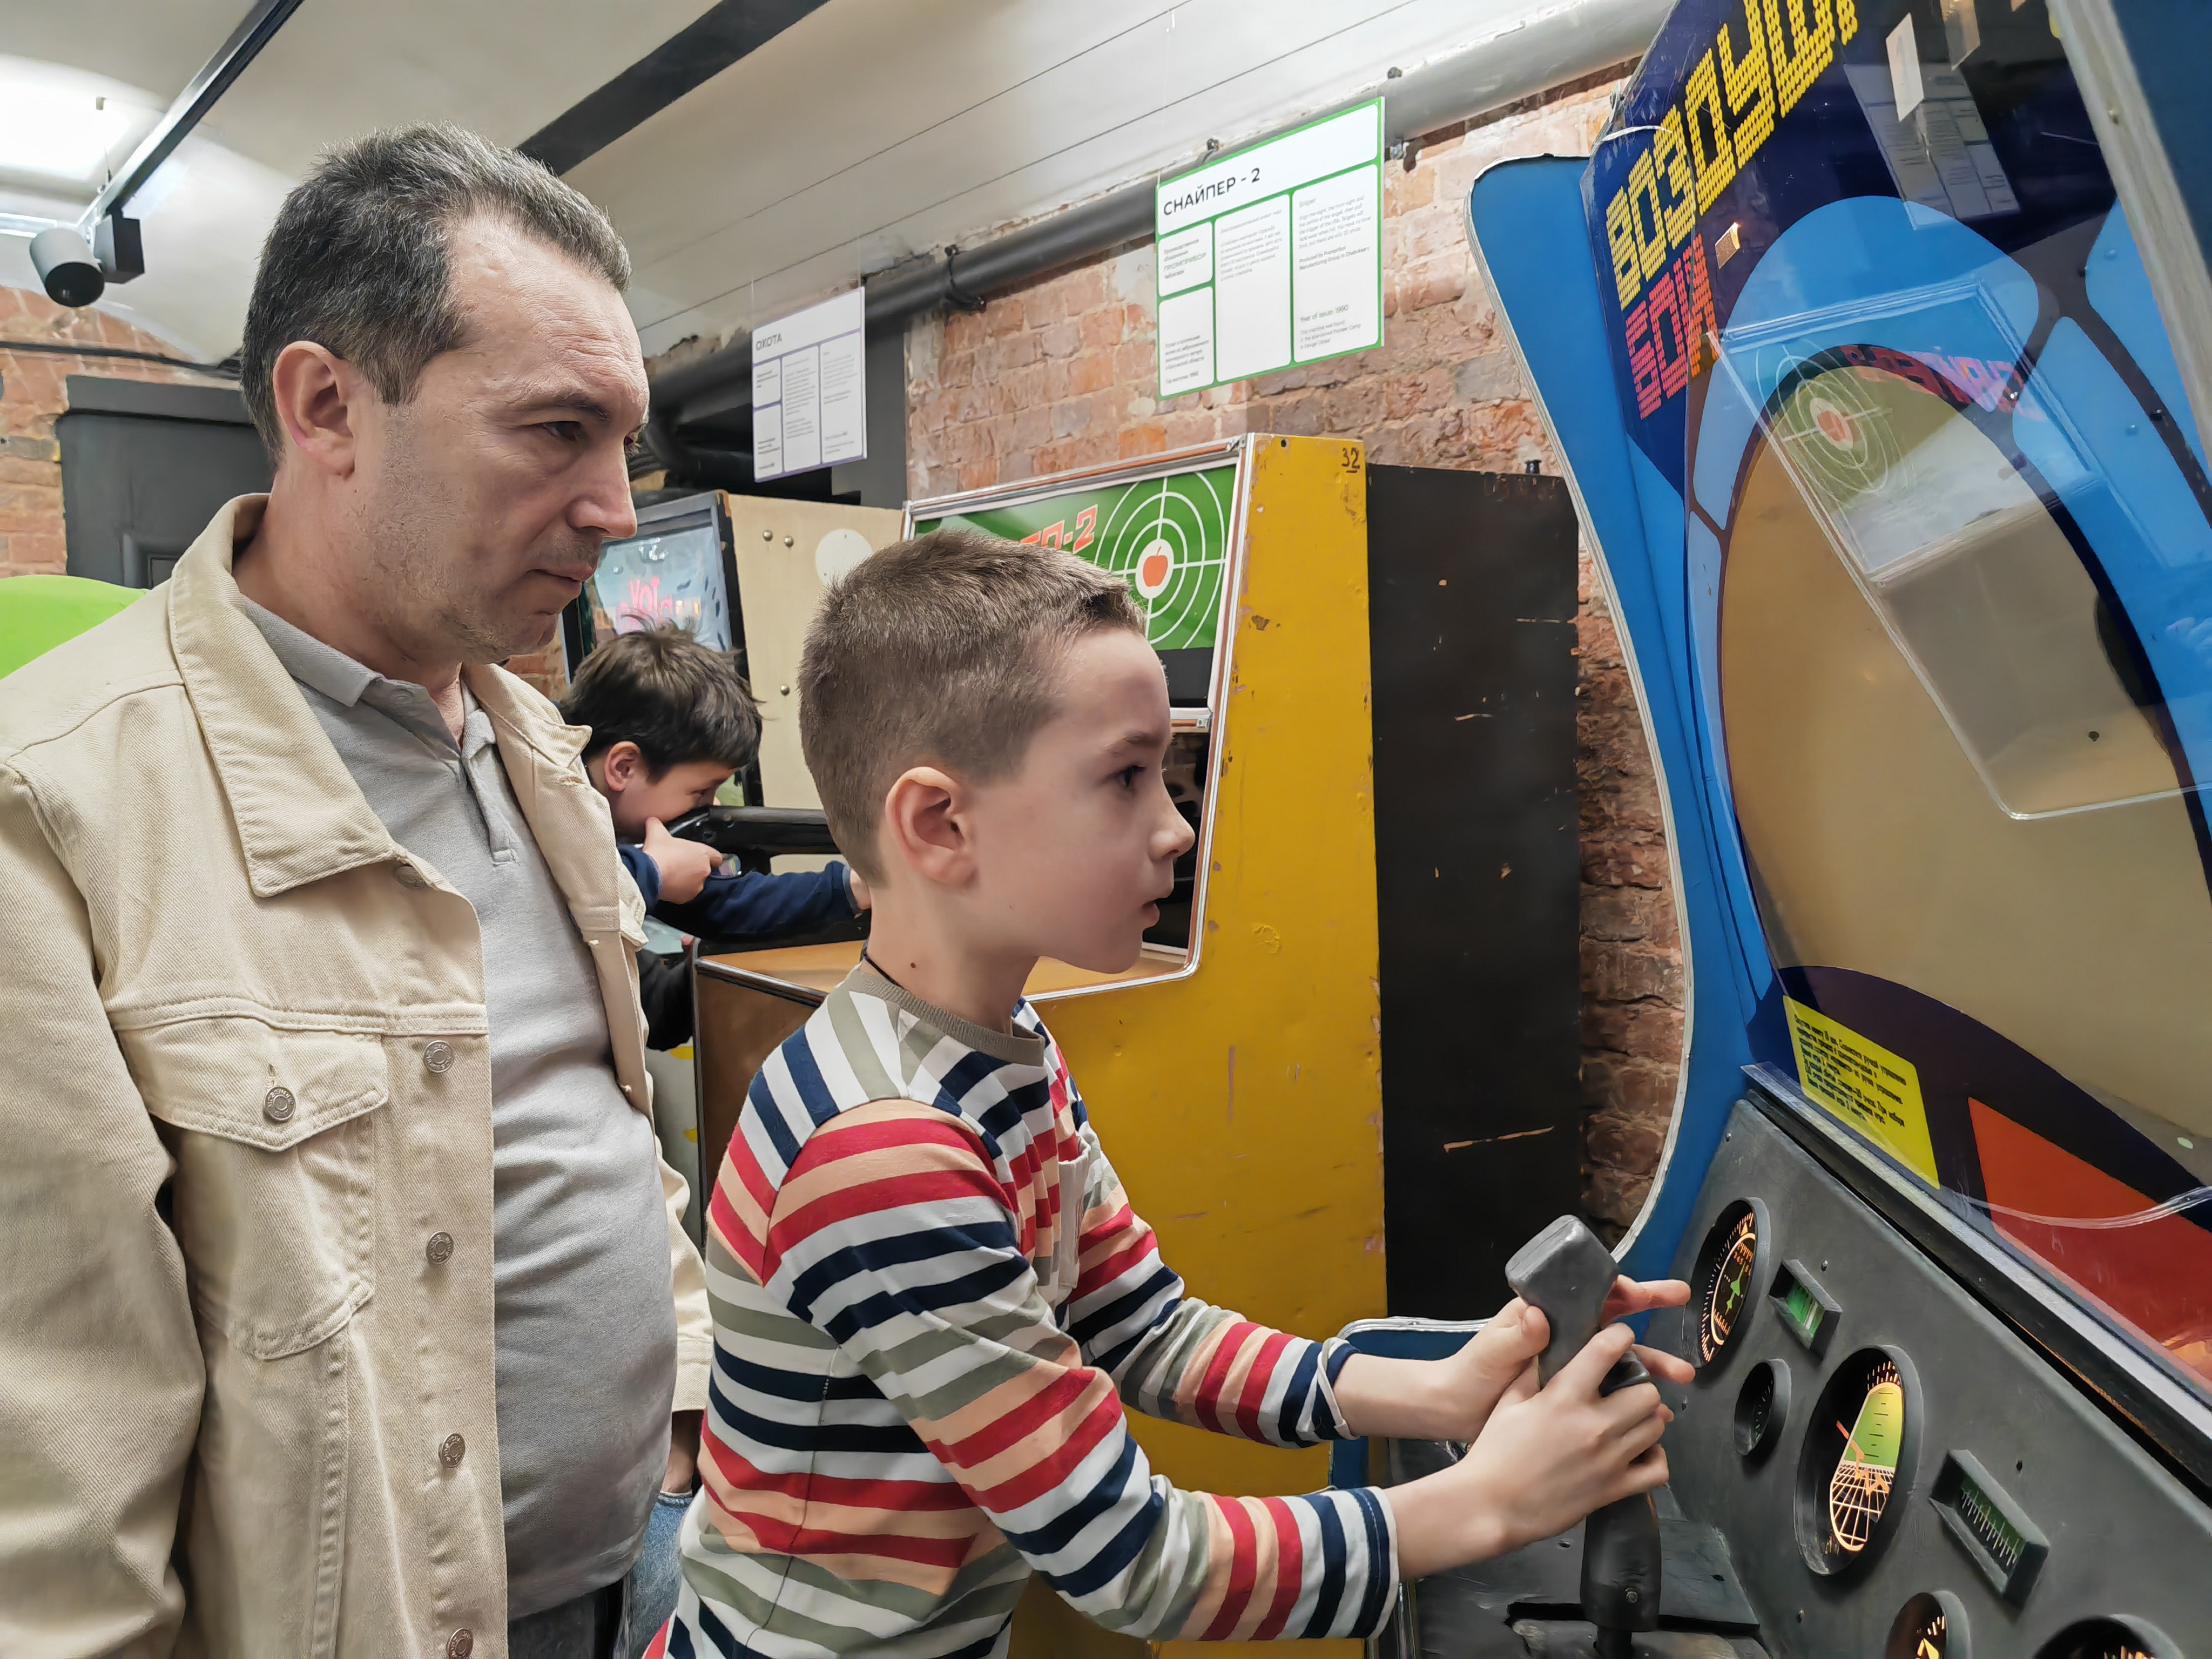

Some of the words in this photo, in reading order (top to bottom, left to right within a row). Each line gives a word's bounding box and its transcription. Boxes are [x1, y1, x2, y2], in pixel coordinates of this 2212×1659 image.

[1606, 0, 1858, 312] ВОЗДУШ
[1164, 177, 1236, 215] СНАЙПЕР
[1251, 167, 1260, 184] 2
[756, 333, 782, 351] ОХОТА
[1341, 447, 1361, 469] 32
